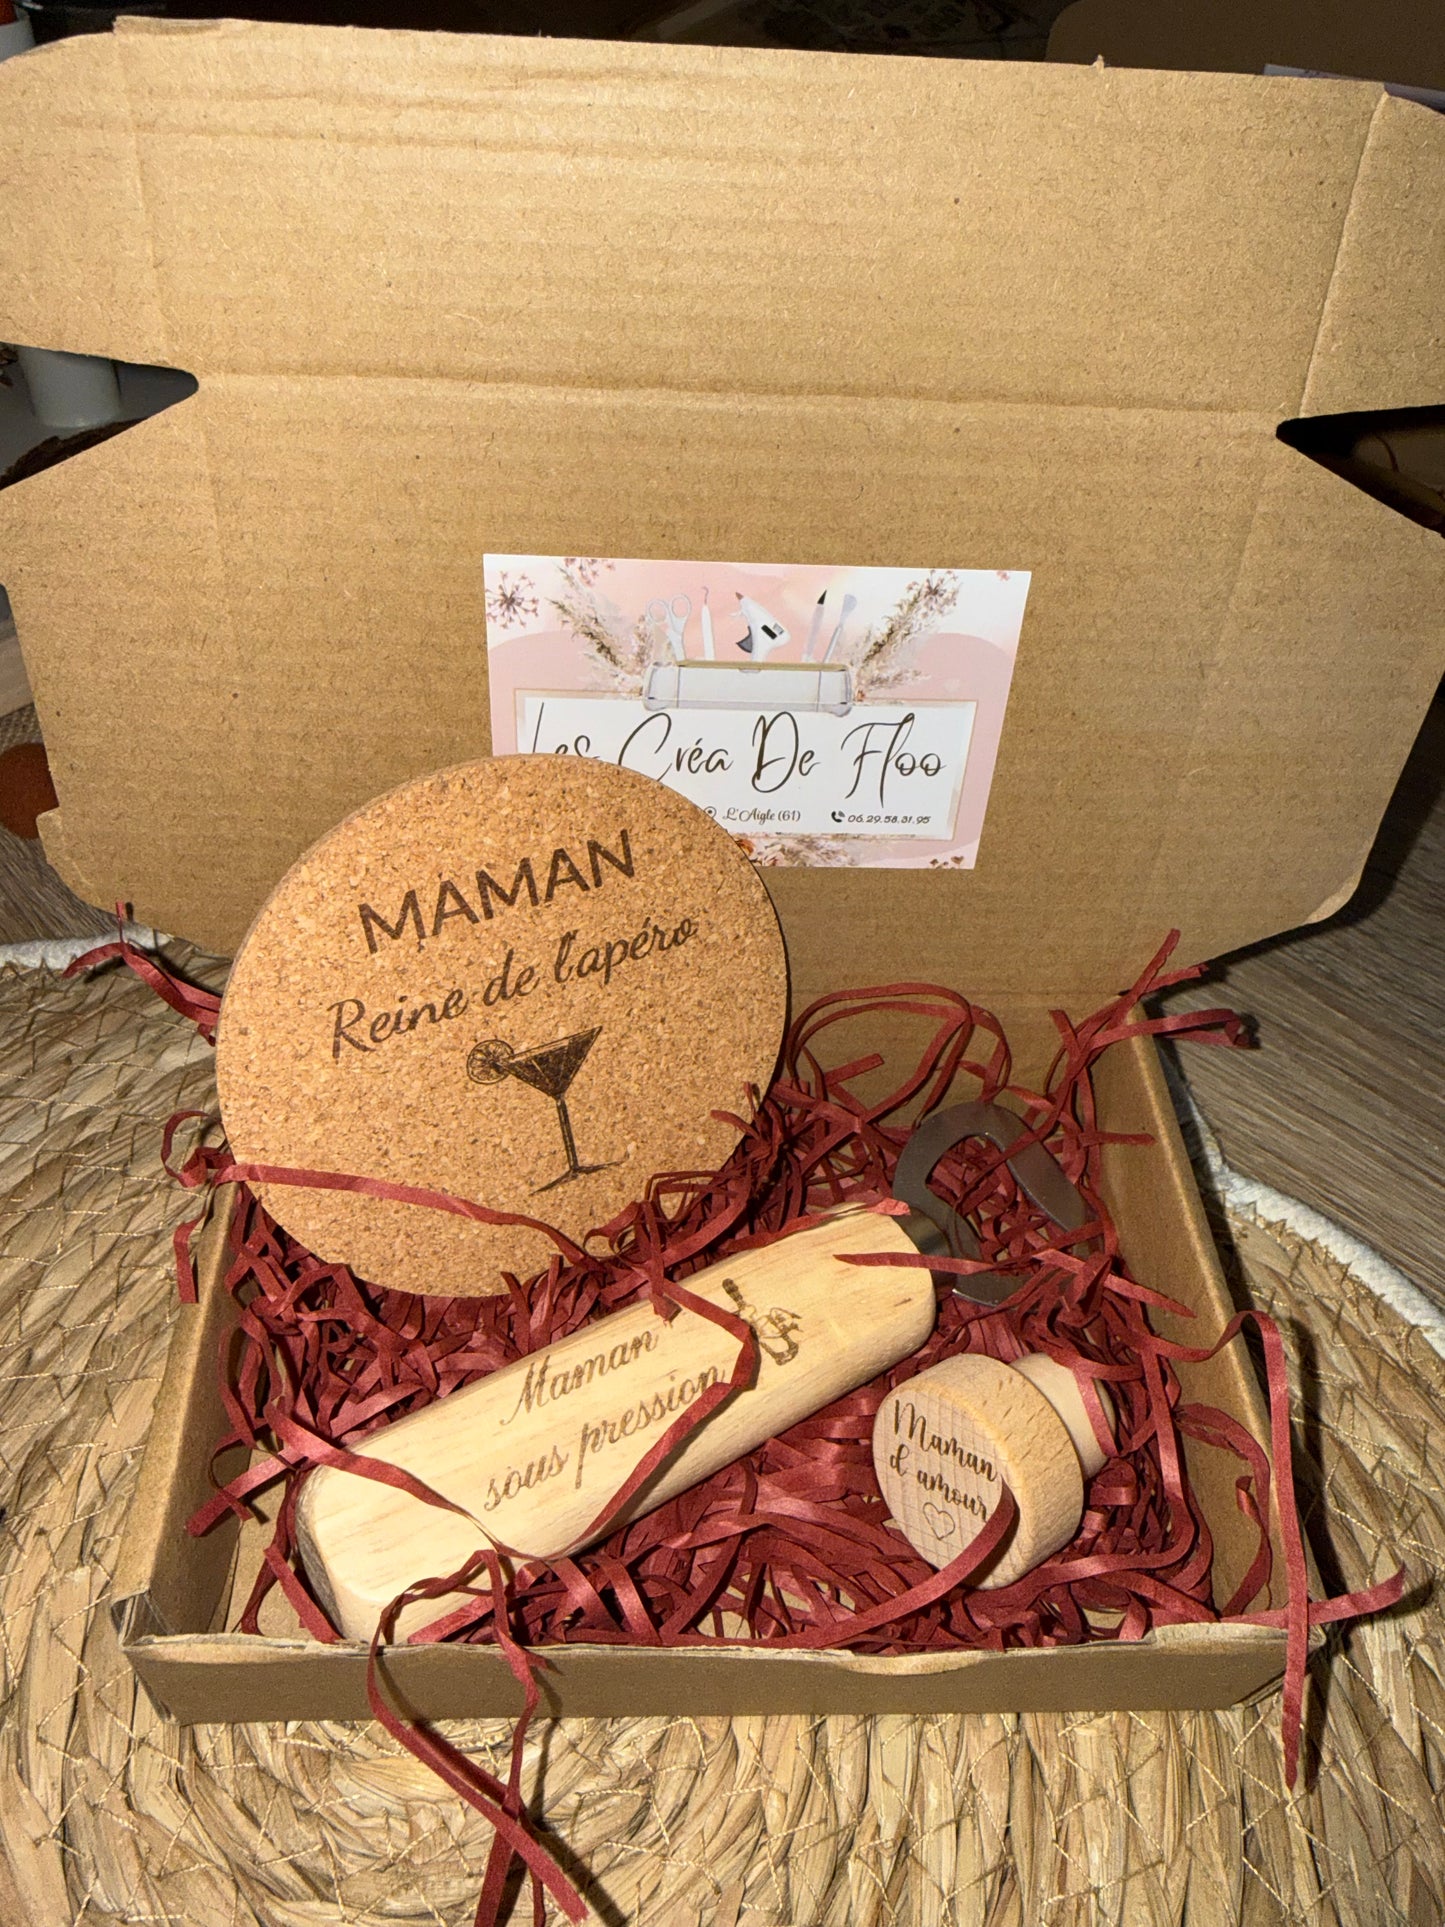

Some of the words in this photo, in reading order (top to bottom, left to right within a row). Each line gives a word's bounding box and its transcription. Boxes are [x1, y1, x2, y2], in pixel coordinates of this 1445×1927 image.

[617, 712, 735, 783] Créa
[751, 711, 822, 794] De
[840, 711, 948, 808] Floo
[722, 807, 776, 825] L'Aigle
[778, 809, 801, 822] (61)
[357, 829, 636, 955] MAMAN
[326, 987, 470, 1061] Reine
[482, 948, 542, 1007] de
[499, 1329, 660, 1426] Maman
[483, 1444, 570, 1512] sous
[574, 1364, 726, 1490] pression
[893, 1398, 998, 1483] Maman
[916, 1469, 988, 1524] amour
